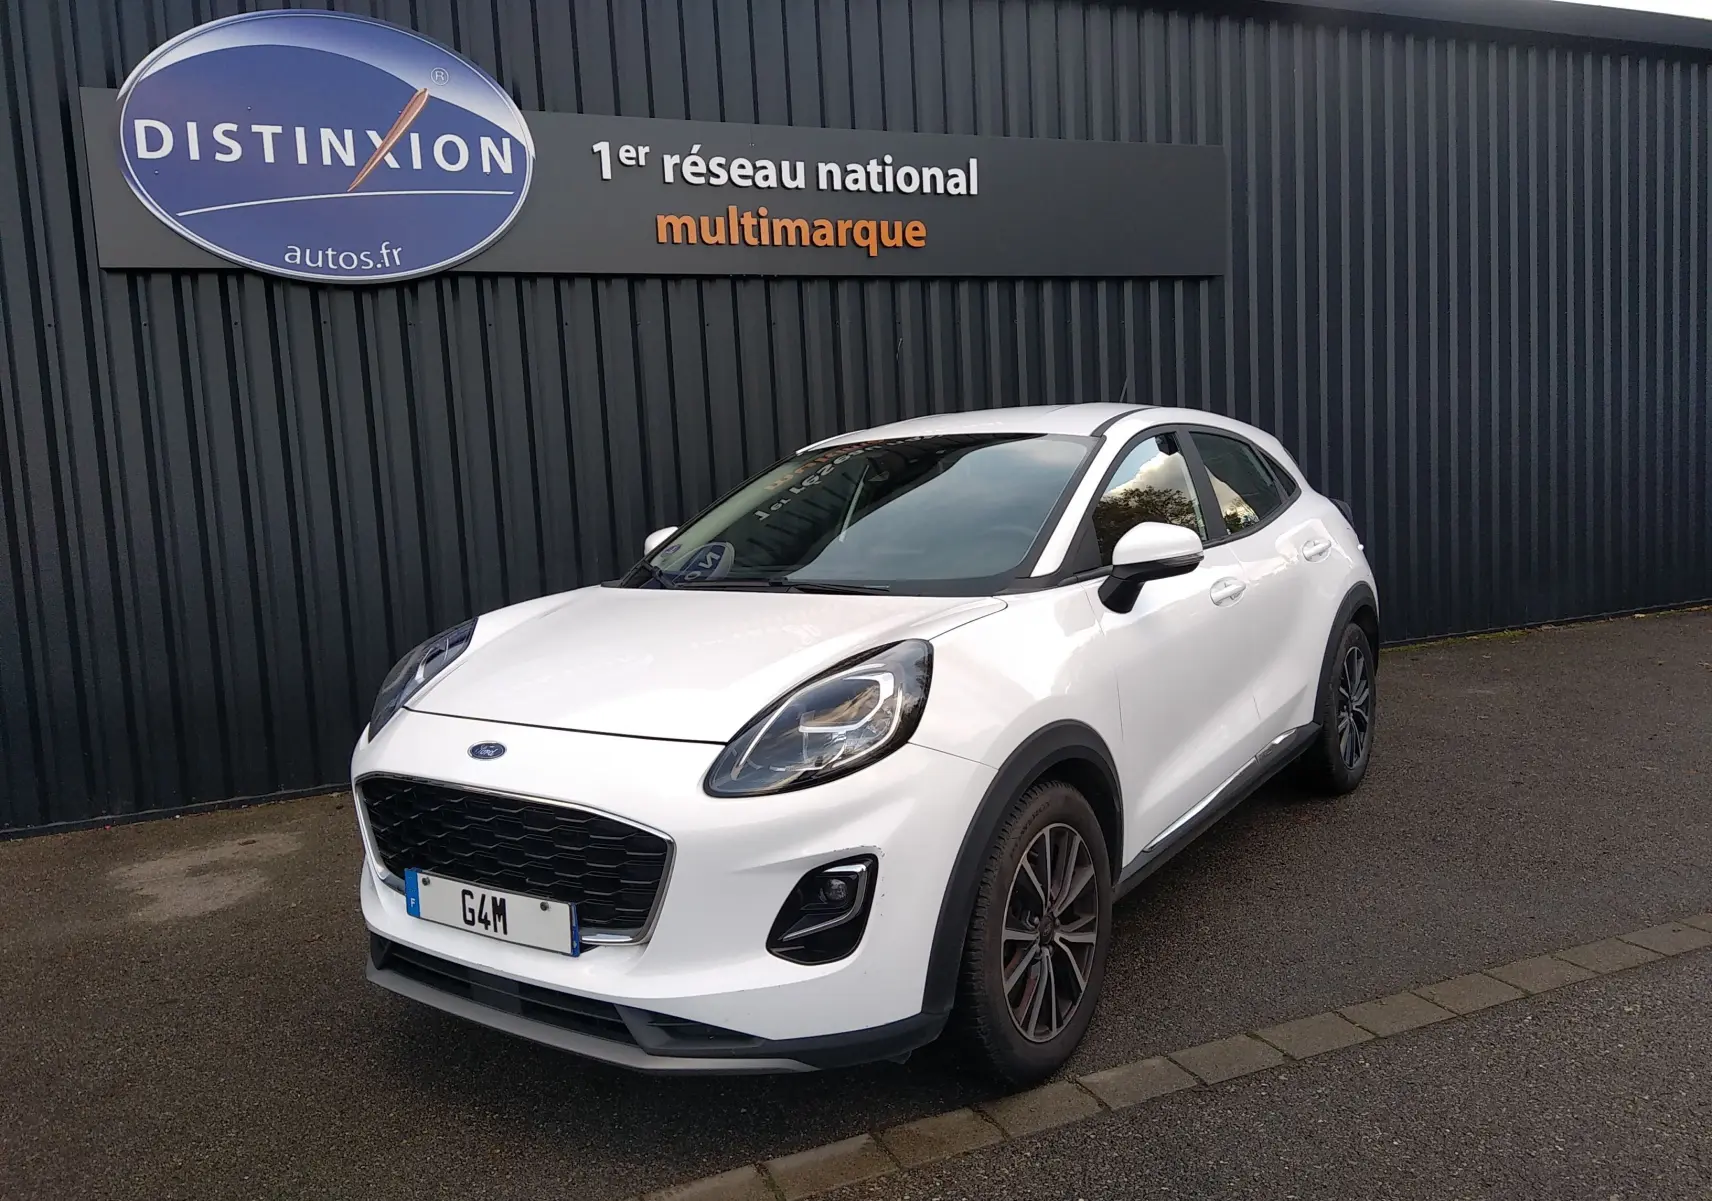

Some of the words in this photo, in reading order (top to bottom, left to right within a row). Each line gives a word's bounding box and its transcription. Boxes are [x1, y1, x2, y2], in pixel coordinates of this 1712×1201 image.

[133, 118, 514, 175] DISTINXION
[662, 144, 806, 190] réseau
[818, 154, 979, 196] national
[284, 241, 402, 271] autos.fr
[656, 205, 928, 257] multimarque
[461, 889, 508, 936] G4M
